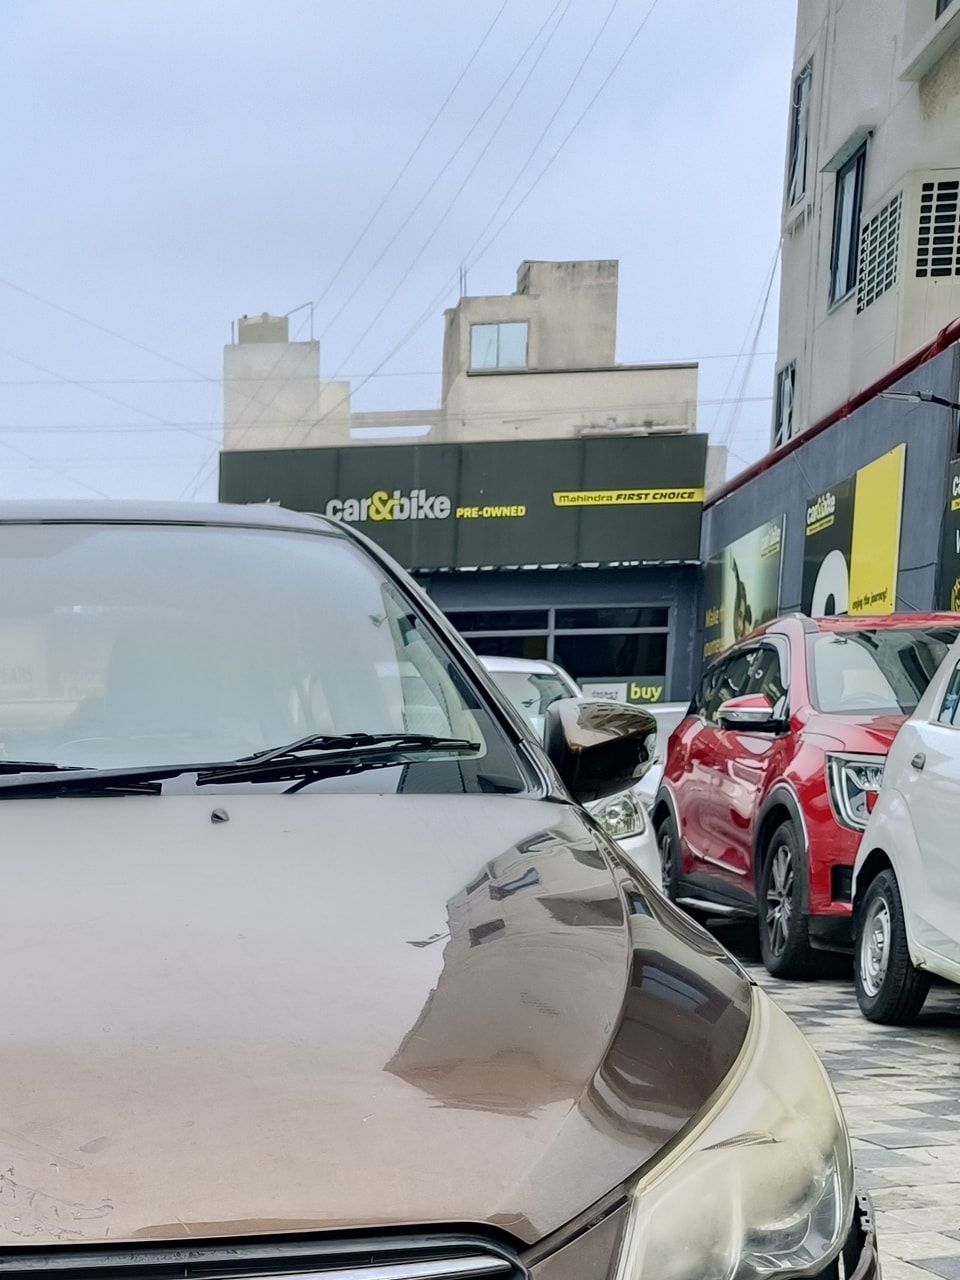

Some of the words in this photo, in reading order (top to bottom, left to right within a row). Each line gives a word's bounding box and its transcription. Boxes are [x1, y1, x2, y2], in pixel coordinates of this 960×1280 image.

[326, 488, 451, 522] car&bike
[456, 505, 526, 518] PRE-OWNED
[559, 494, 613, 503] Mahindra
[615, 492, 650, 501] FIRST
[652, 491, 695, 500] CHOICE
[630, 682, 663, 702] buy
